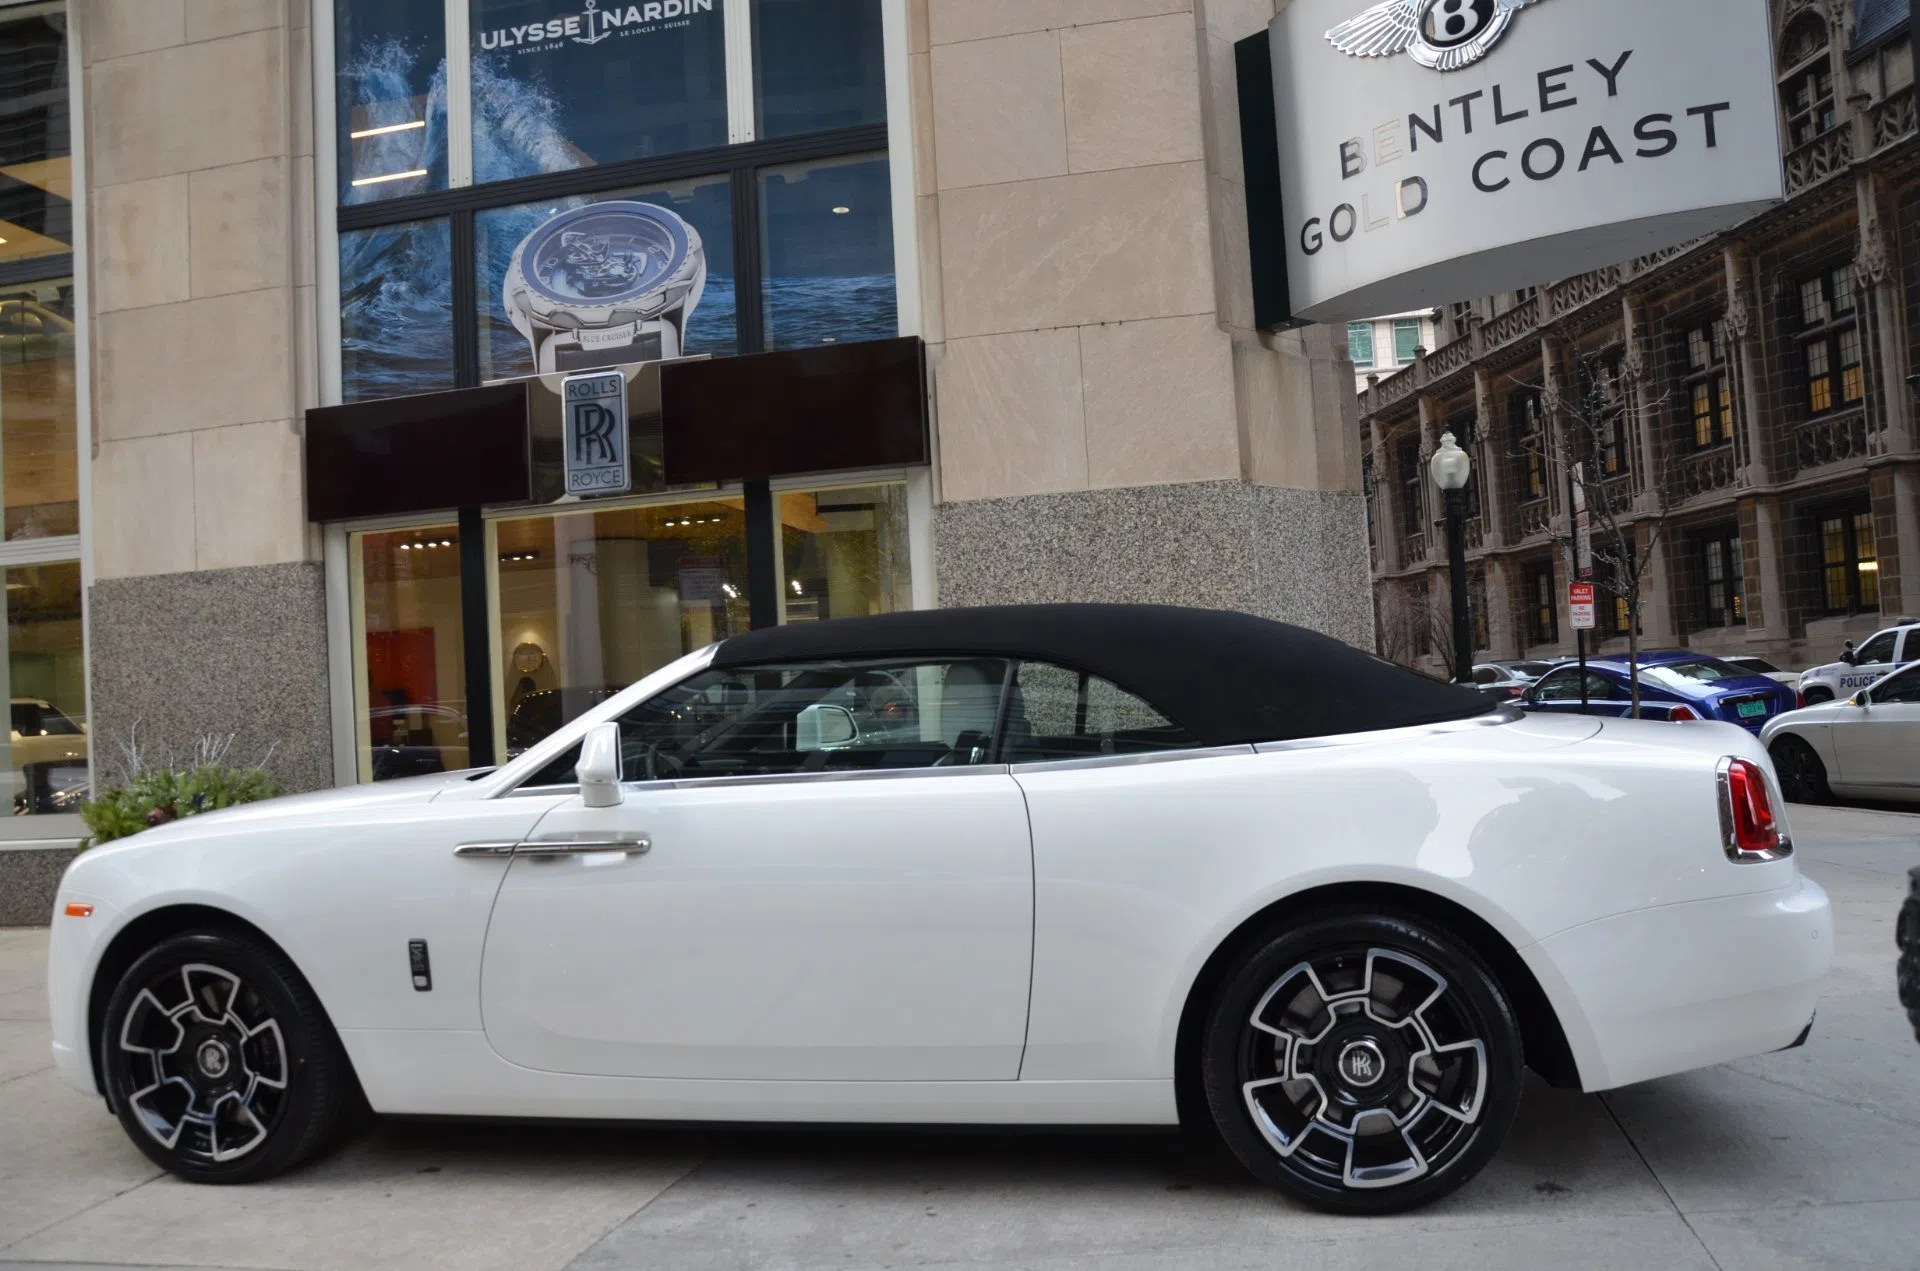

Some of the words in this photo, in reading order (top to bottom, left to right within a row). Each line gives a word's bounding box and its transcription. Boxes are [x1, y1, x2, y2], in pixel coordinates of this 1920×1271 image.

[480, 16, 581, 50] ULYSSE
[602, 0, 713, 29] NARDIN
[631, 26, 656, 35] LOCLE
[664, 20, 691, 30] SUISSE
[518, 46, 541, 55] SINCE
[544, 41, 564, 51] 1846
[1340, 50, 1634, 180] BENTLEY
[1300, 175, 1428, 256] GOLD
[1471, 101, 1730, 193] COAST
[582, 335, 600, 343] BLUE
[601, 329, 632, 342] CRUISER
[568, 379, 617, 397] ROLLS
[571, 469, 620, 487] ROYCE
